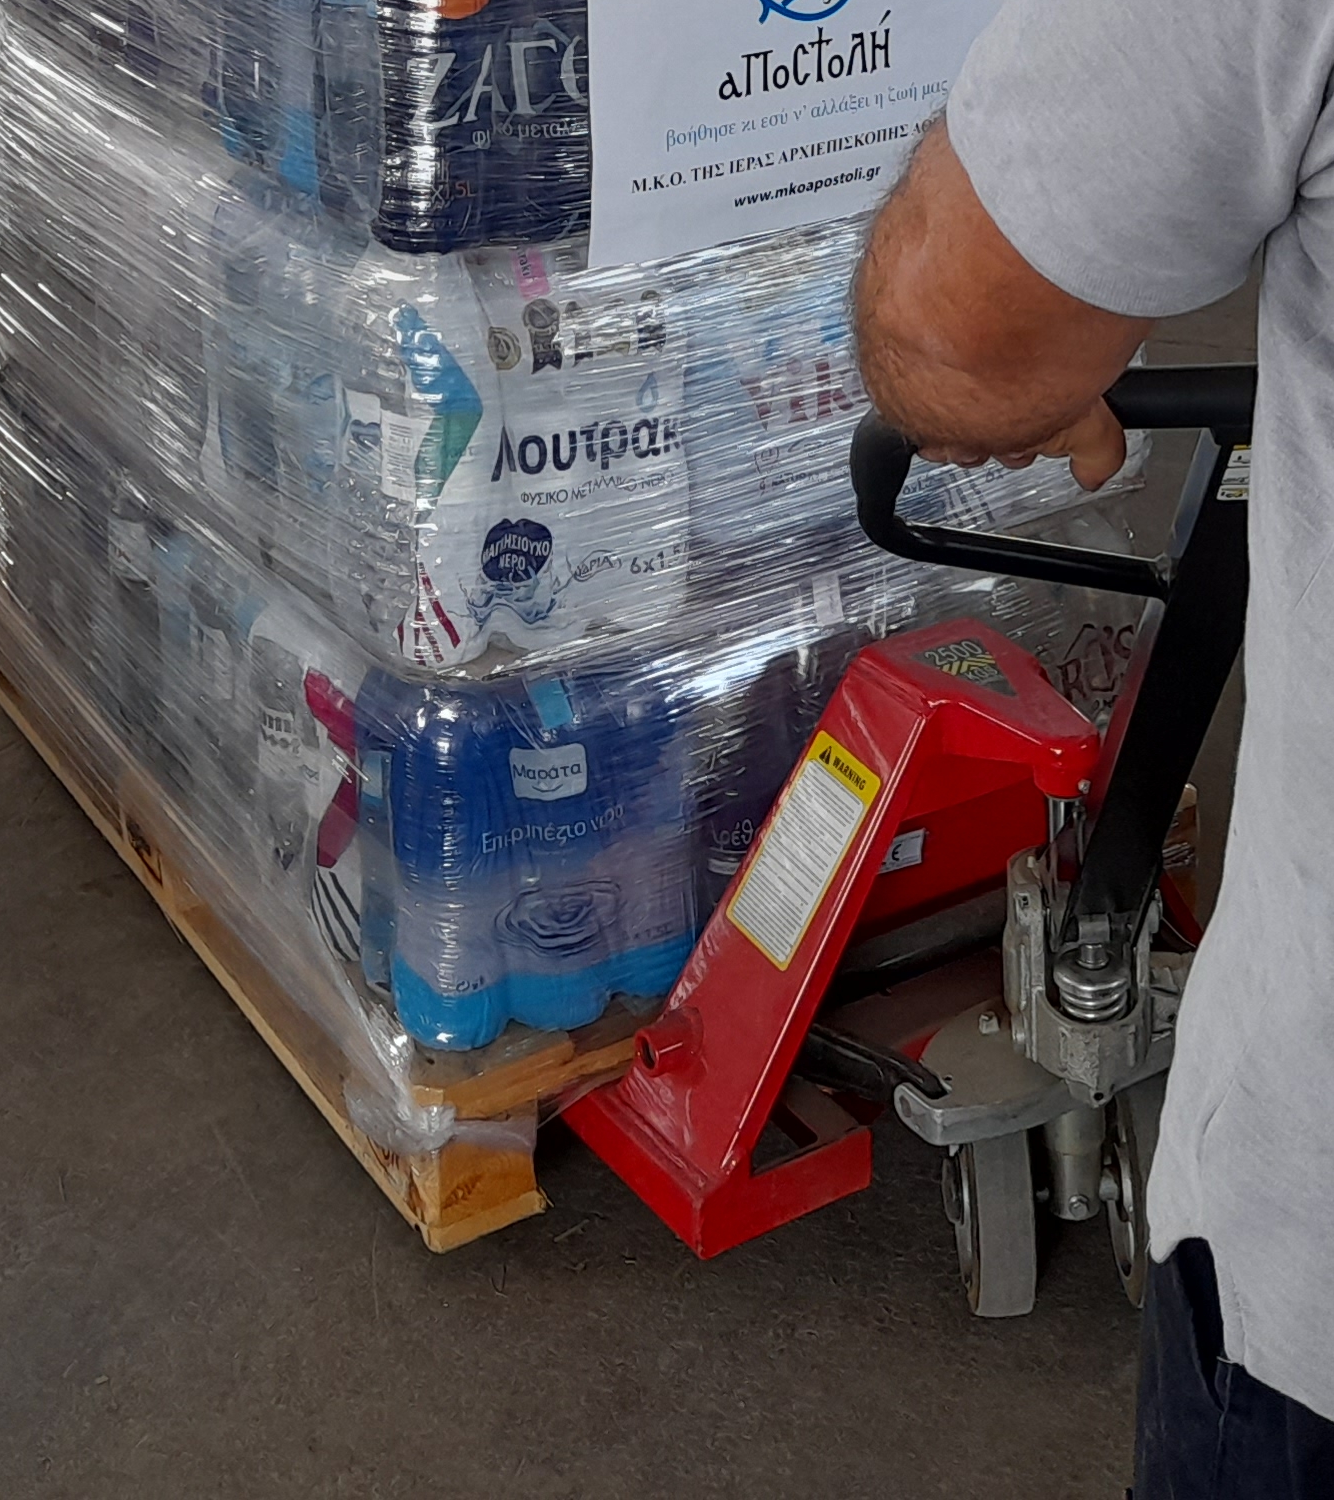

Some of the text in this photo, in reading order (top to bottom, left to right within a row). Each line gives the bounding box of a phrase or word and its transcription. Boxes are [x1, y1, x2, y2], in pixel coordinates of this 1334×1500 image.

[666, 123, 737, 152] βοήθησε
[760, 107, 788, 129] εσύ
[810, 93, 870, 119] αλλάξει
[874, 92, 884, 109] η
[887, 84, 918, 104] ζωή
[921, 79, 949, 101] μας
[631, 169, 687, 194] Μ.Κ.Ο.
[691, 162, 725, 184] ΤΗΣ
[728, 153, 775, 177] ΙΕΡΑΣ
[778, 123, 909, 165] ΑΡΧΙΕΠΙΣΚΟΠΗΣ
[733, 163, 881, 208] www.mkoapostoli.gr
[520, 487, 568, 506] ΦΥΣΙΚΟ
[498, 552, 526, 571] ΝΕΡΟ
[924, 640, 983, 666] 2500
[832, 754, 867, 792] WARNING
